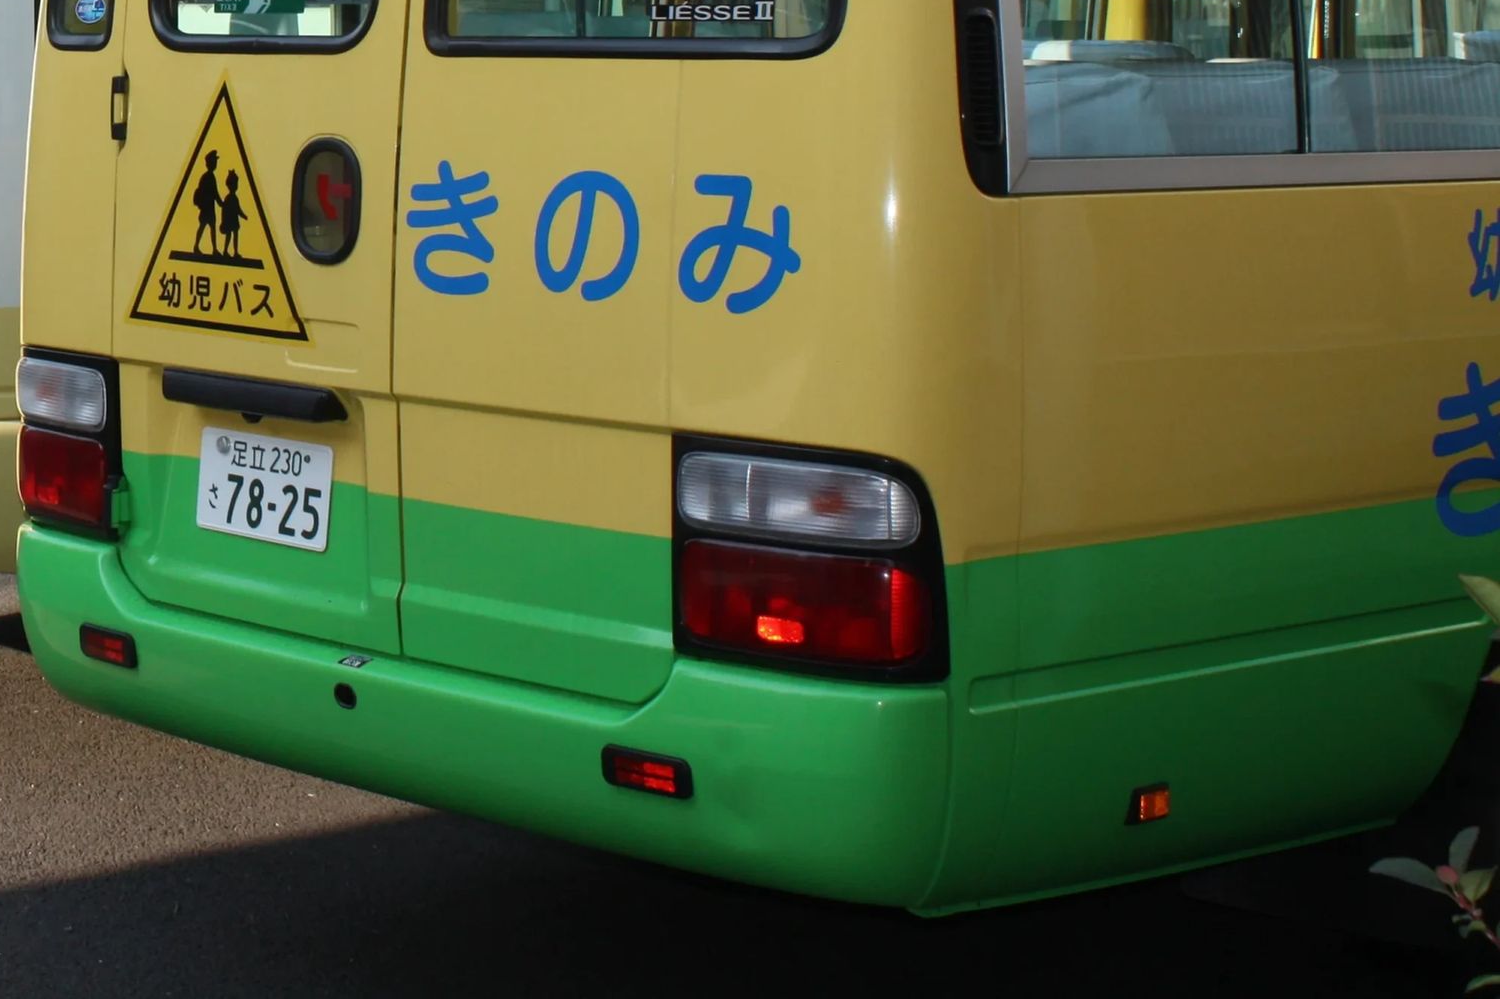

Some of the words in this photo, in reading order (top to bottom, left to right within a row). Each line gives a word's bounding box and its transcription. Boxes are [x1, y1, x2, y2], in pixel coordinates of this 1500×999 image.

[651, 1, 752, 20] LIÉSSE
[406, 160, 801, 314] きのみ
[158, 271, 274, 318] 幼児バス
[231, 440, 266, 471] 足立
[270, 447, 303, 476] 230
[226, 473, 322, 540] 78-25
